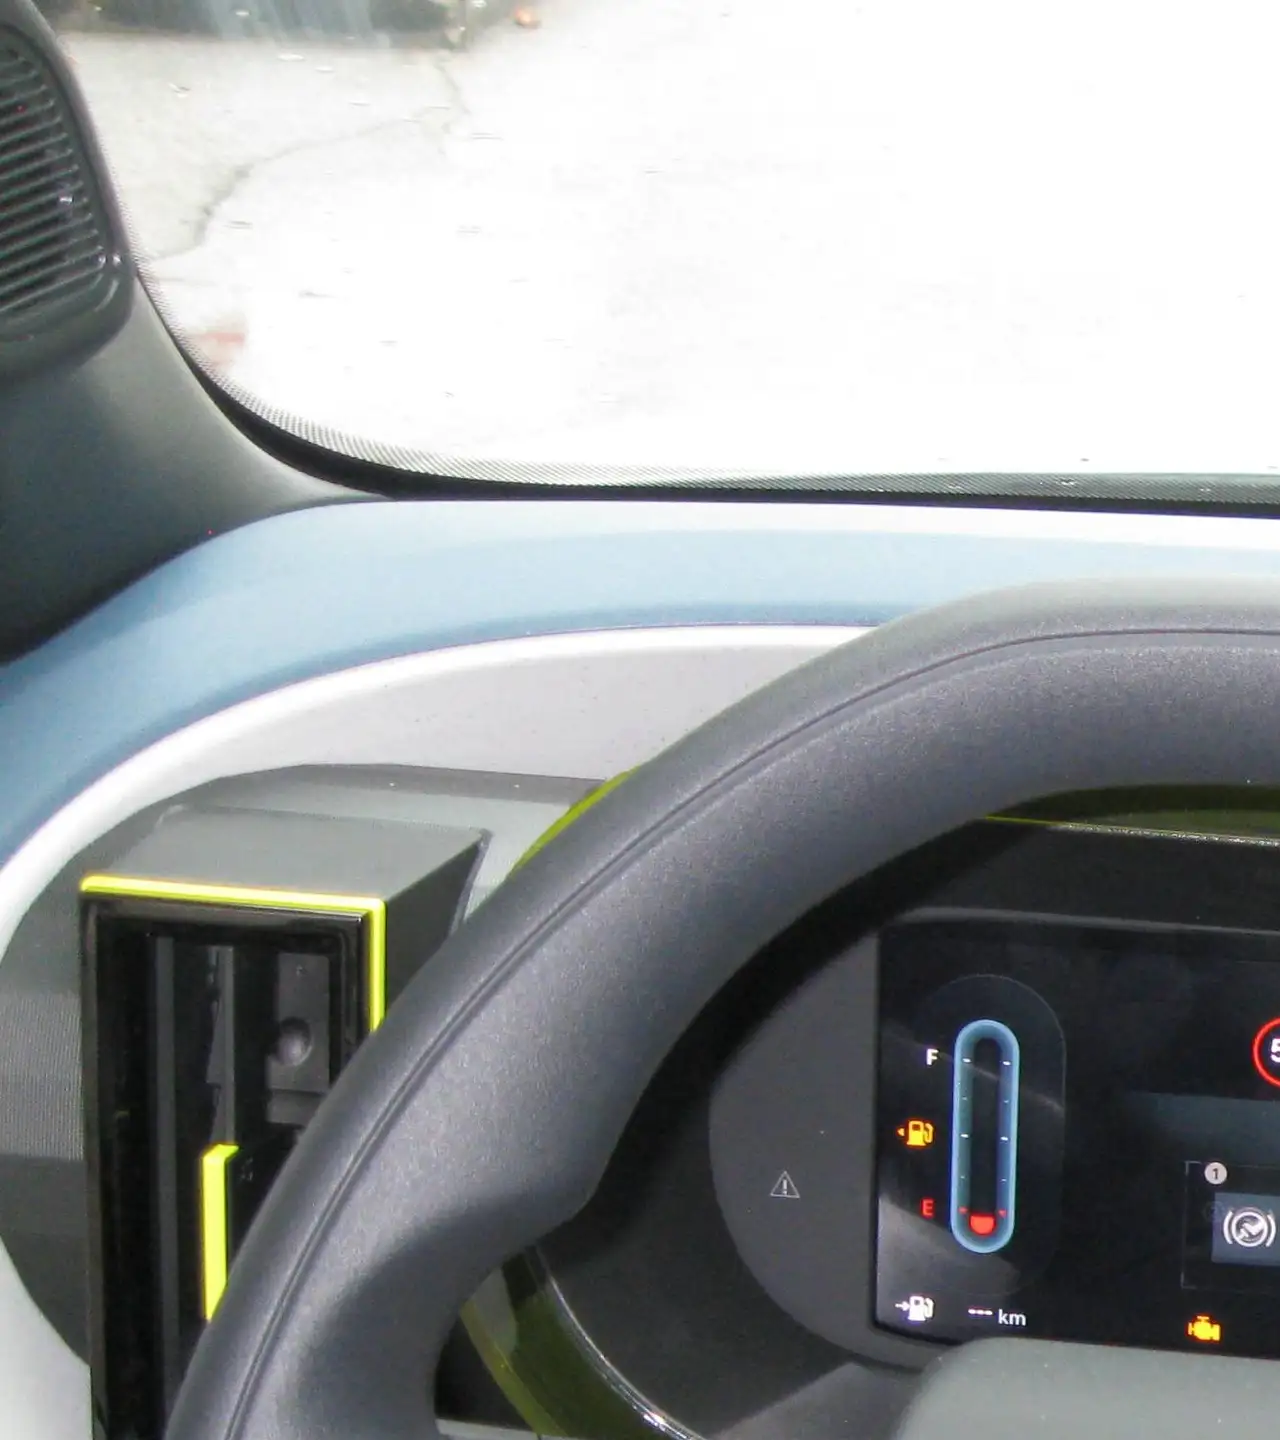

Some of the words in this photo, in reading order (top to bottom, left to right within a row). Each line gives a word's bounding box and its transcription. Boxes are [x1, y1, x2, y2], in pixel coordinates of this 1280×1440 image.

[926, 1048, 939, 1066] F
[921, 1198, 934, 1218] E
[997, 1309, 1027, 1326] km
